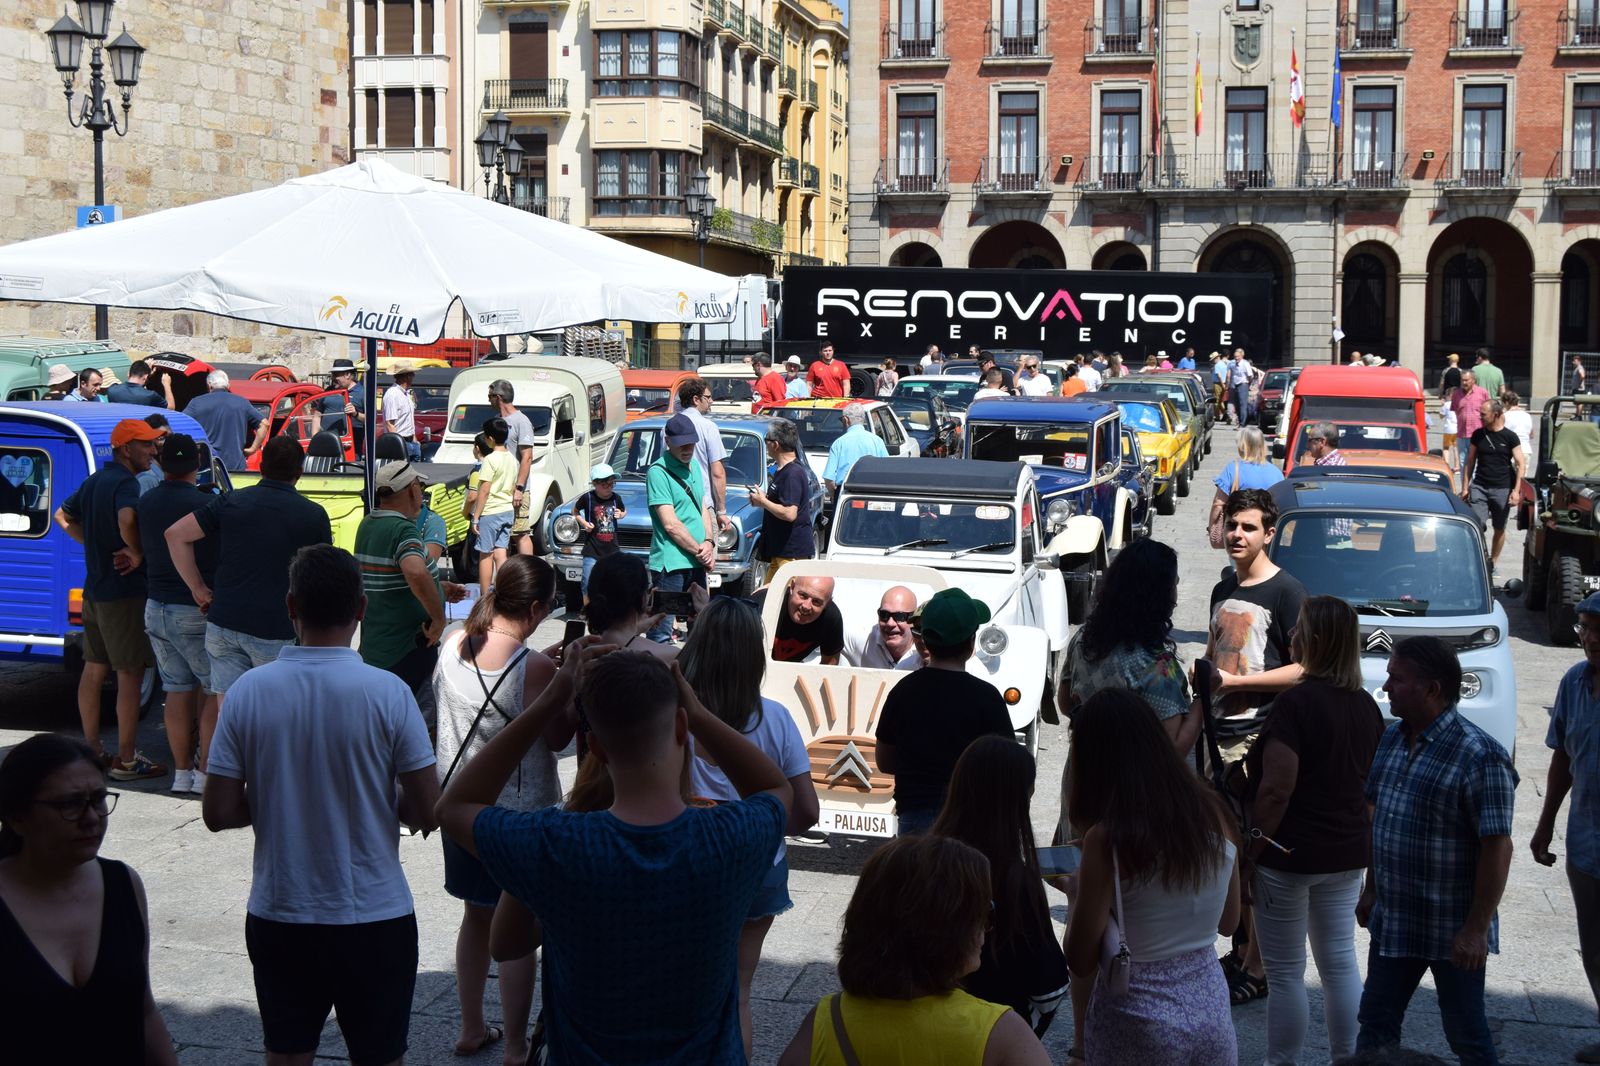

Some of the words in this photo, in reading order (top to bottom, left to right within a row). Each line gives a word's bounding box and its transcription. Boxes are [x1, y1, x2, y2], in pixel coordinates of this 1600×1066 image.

[710, 293, 717, 302] EL
[389, 303, 401, 314] EL
[694, 300, 732, 318] ÁGUILA
[350, 307, 420, 338] ÁGUILA
[817, 323, 1232, 346] EXPERIENCE
[834, 813, 887, 833] PALAUSA
